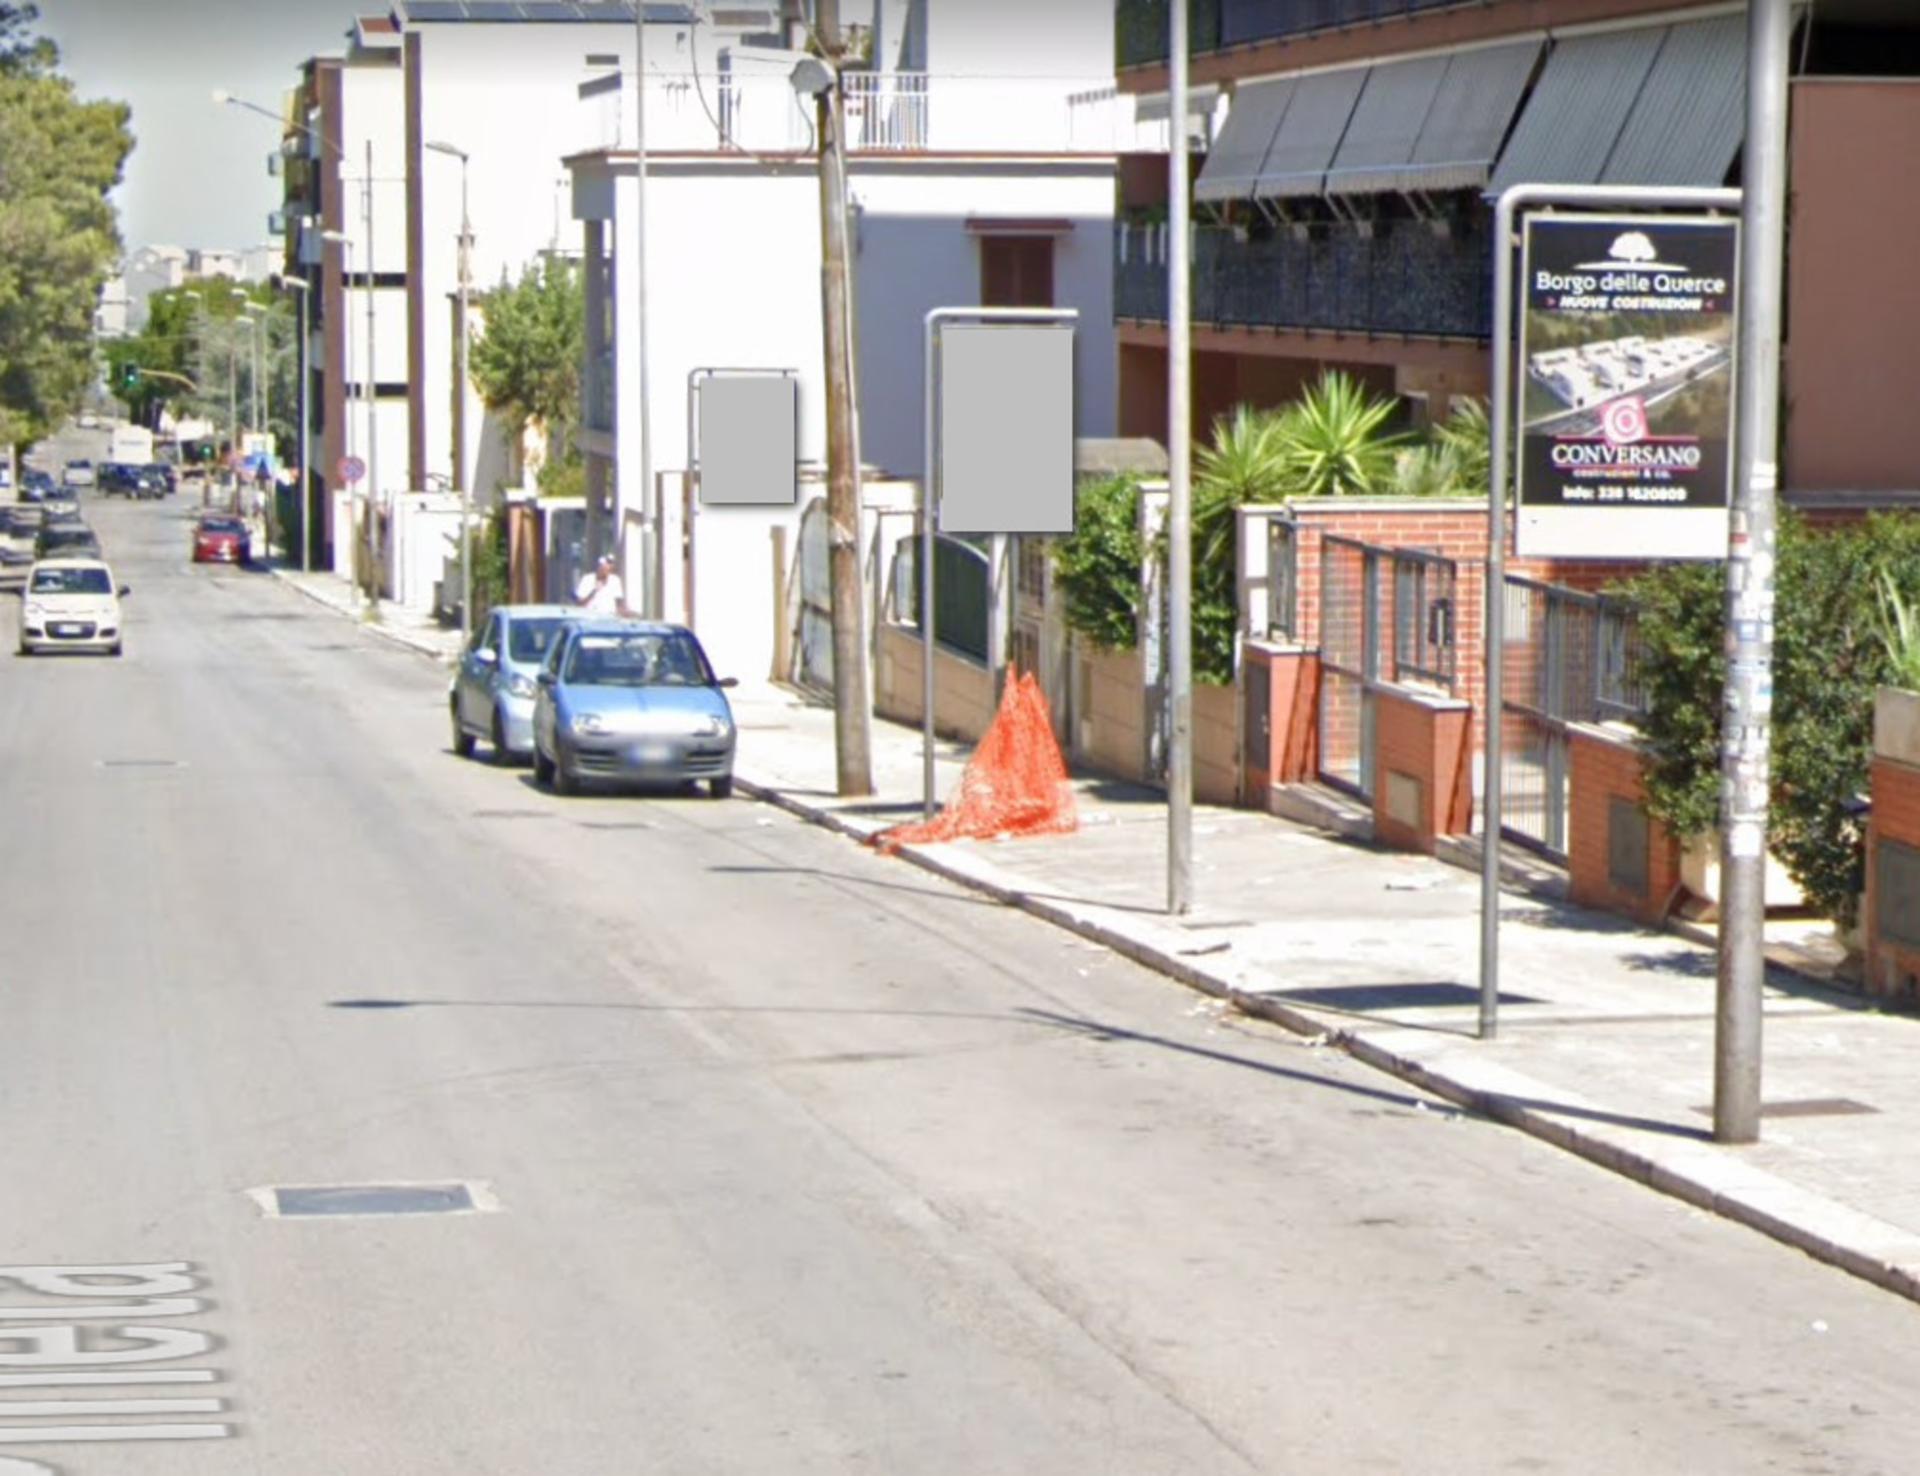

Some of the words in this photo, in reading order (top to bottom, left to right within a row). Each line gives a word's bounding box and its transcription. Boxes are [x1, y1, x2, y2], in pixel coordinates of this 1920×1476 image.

[1536, 271, 1596, 295] Borgo
[1600, 273, 1650, 292] delle
[1654, 274, 1726, 294] Querce
[1559, 296, 1608, 309] NUOVE
[1552, 444, 1701, 465] CONVERSANO
